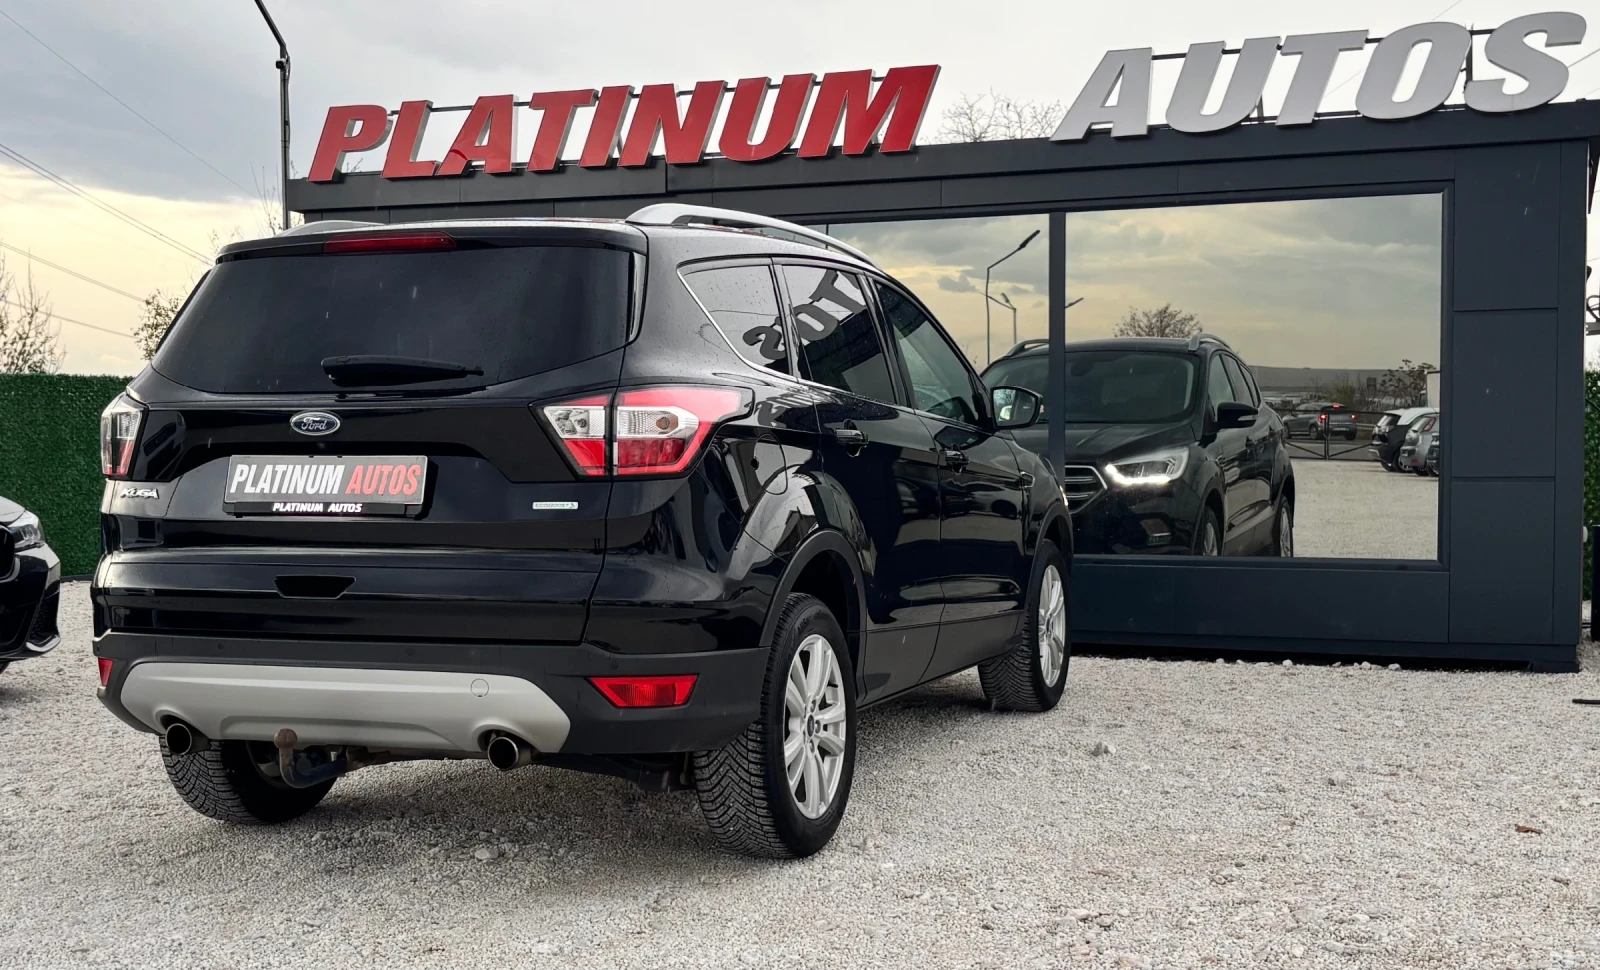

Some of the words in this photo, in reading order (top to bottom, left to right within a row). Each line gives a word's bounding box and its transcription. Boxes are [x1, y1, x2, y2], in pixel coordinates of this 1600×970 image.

[306, 64, 942, 182] PLATINUM
[1048, 11, 1588, 144] AUTOS
[301, 416, 327, 430] Ford
[229, 464, 345, 495] PLATINUM
[345, 464, 421, 495] AUTOS
[120, 488, 159, 499] KUGA
[272, 502, 324, 513] PLATINUM
[327, 502, 363, 513] AUTOS
